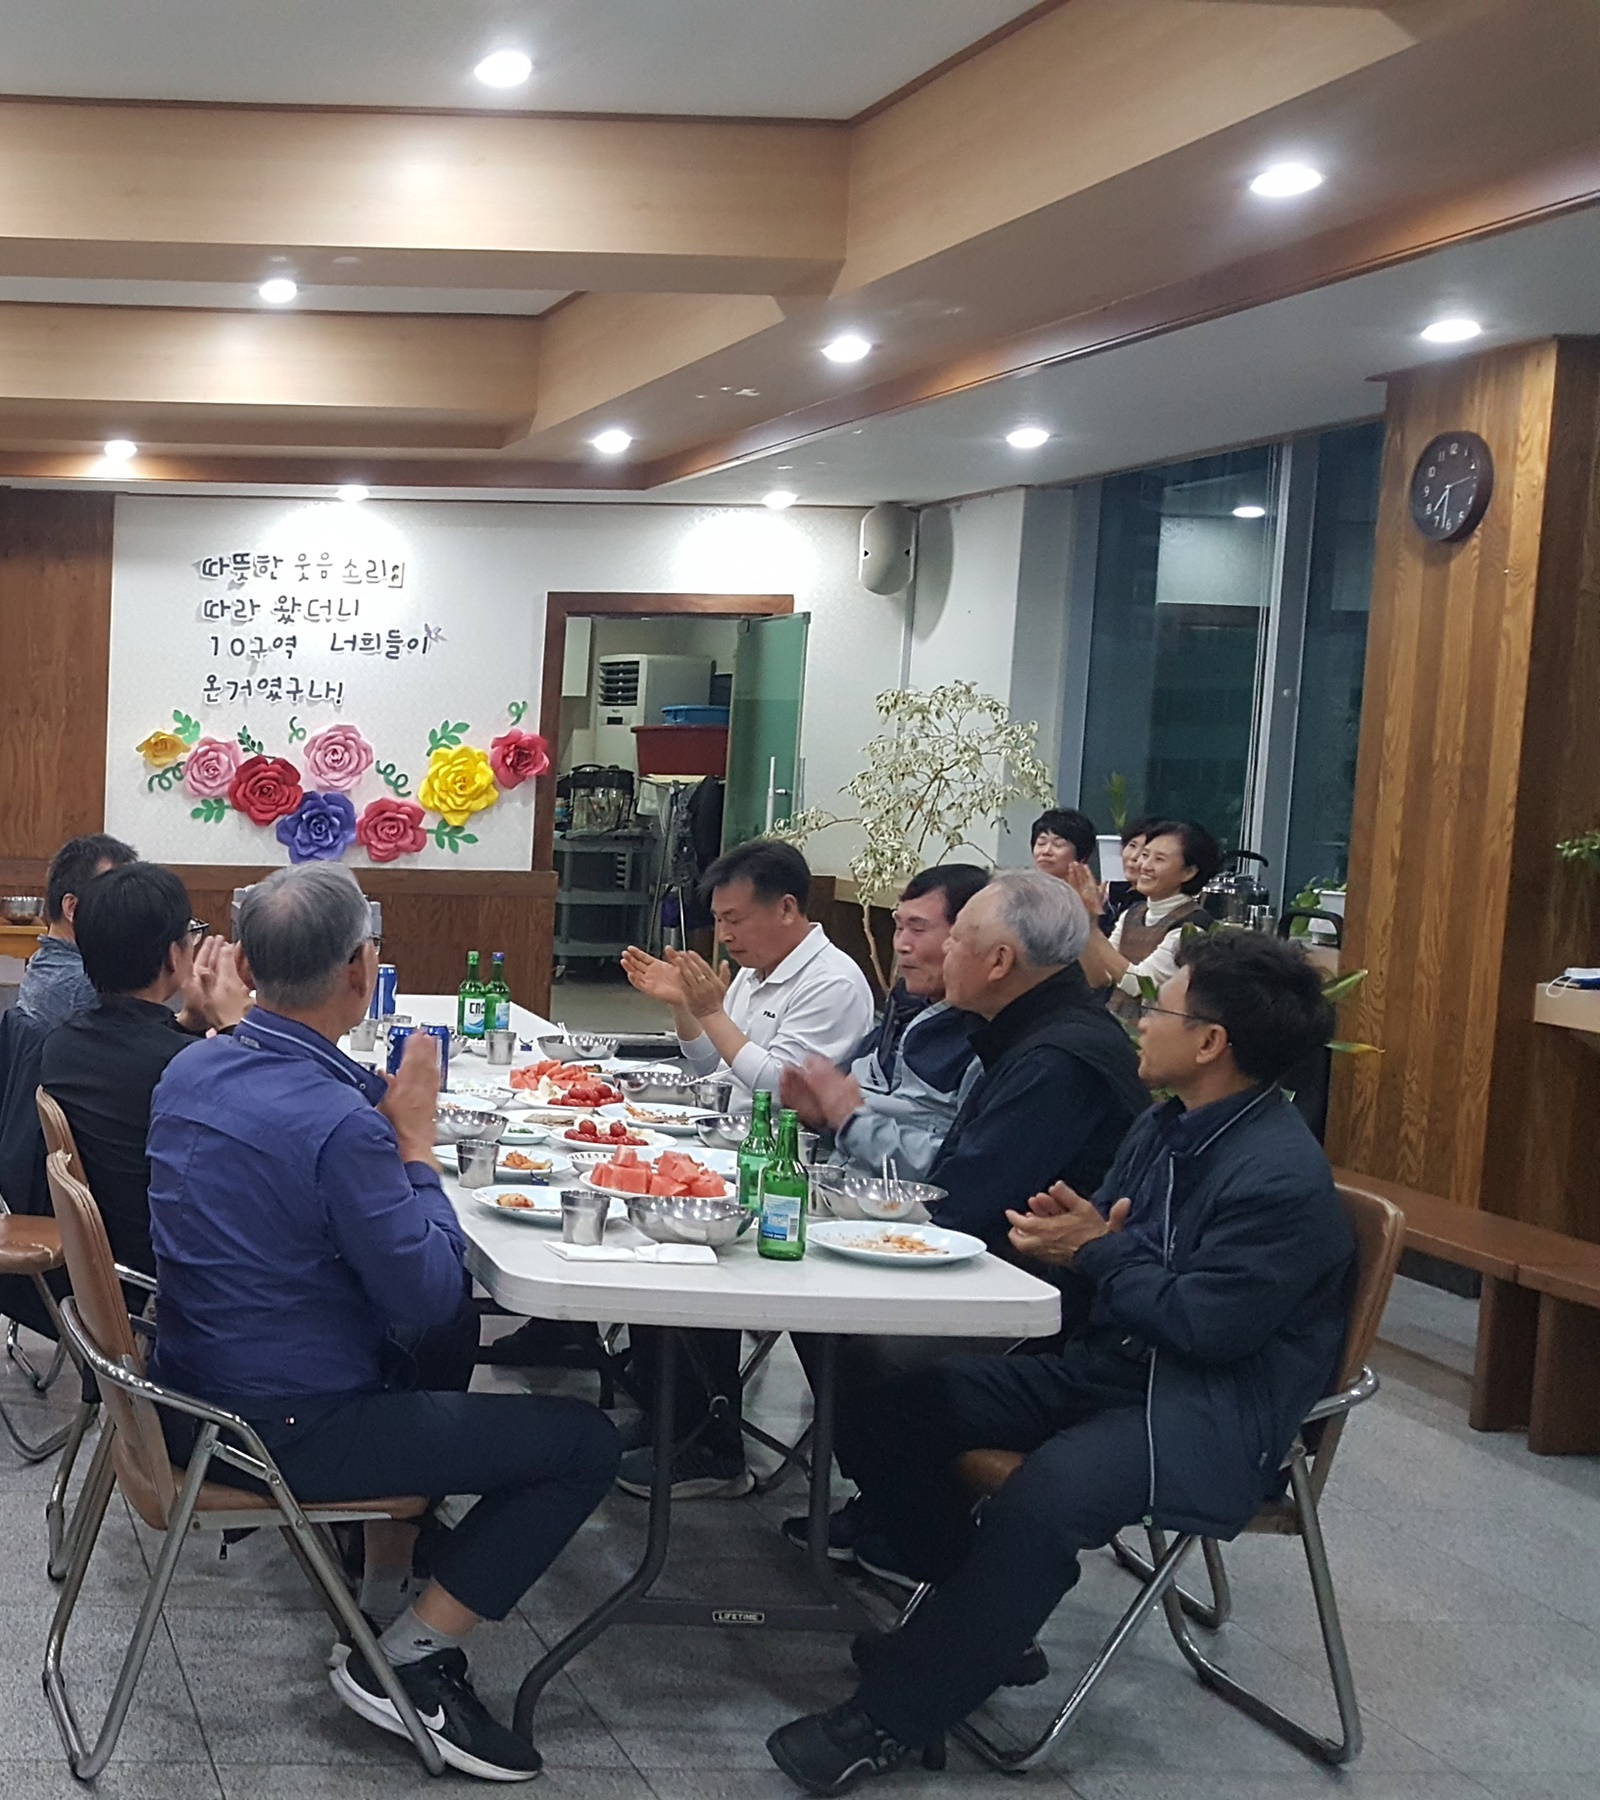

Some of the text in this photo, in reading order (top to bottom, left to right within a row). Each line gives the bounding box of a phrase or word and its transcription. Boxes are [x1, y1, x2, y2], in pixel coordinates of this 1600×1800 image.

[202, 552, 284, 581] 따뜻한
[294, 552, 333, 582] 웃음
[203, 595, 360, 625] 따라 왔더니
[211, 629, 429, 660] 10구역 너희들이
